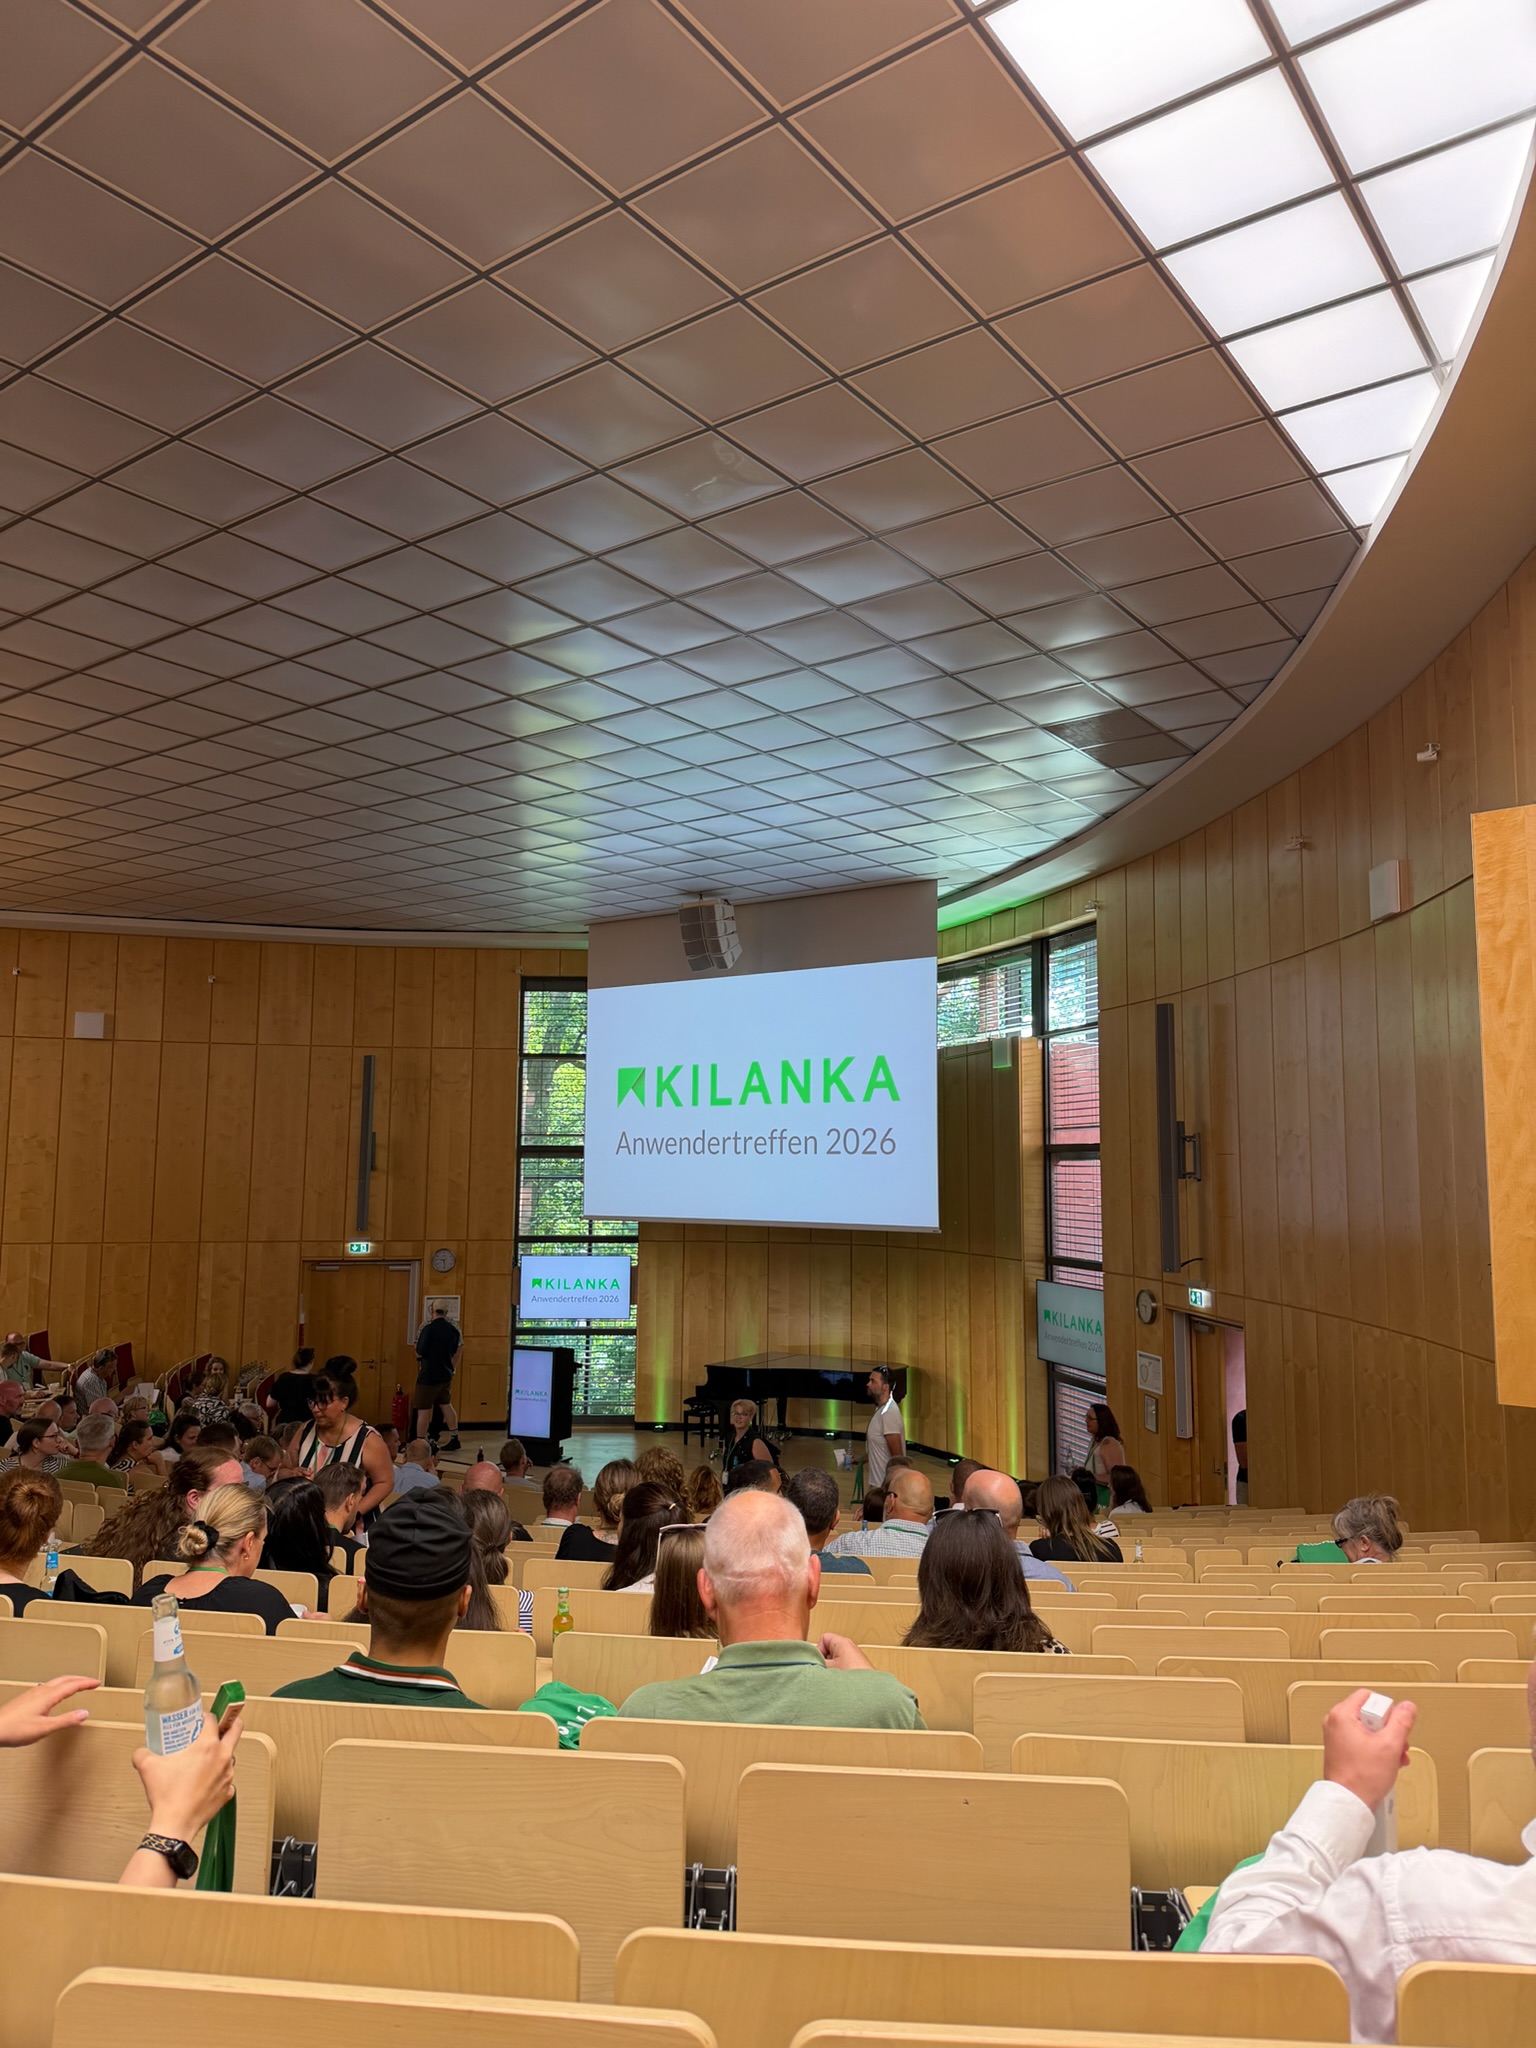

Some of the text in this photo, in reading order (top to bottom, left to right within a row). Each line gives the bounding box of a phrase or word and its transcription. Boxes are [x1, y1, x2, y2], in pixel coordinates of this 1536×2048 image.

[656, 1055, 901, 1107] KILANKA
[615, 1127, 896, 1155] Anwendertreffen 2026
[545, 1278, 620, 1290] KILANKA
[531, 1295, 619, 1303] Anwendertreffen 2026
[1052, 1310, 1103, 1337] KILANKA
[162, 1710, 188, 1724] WASSER
